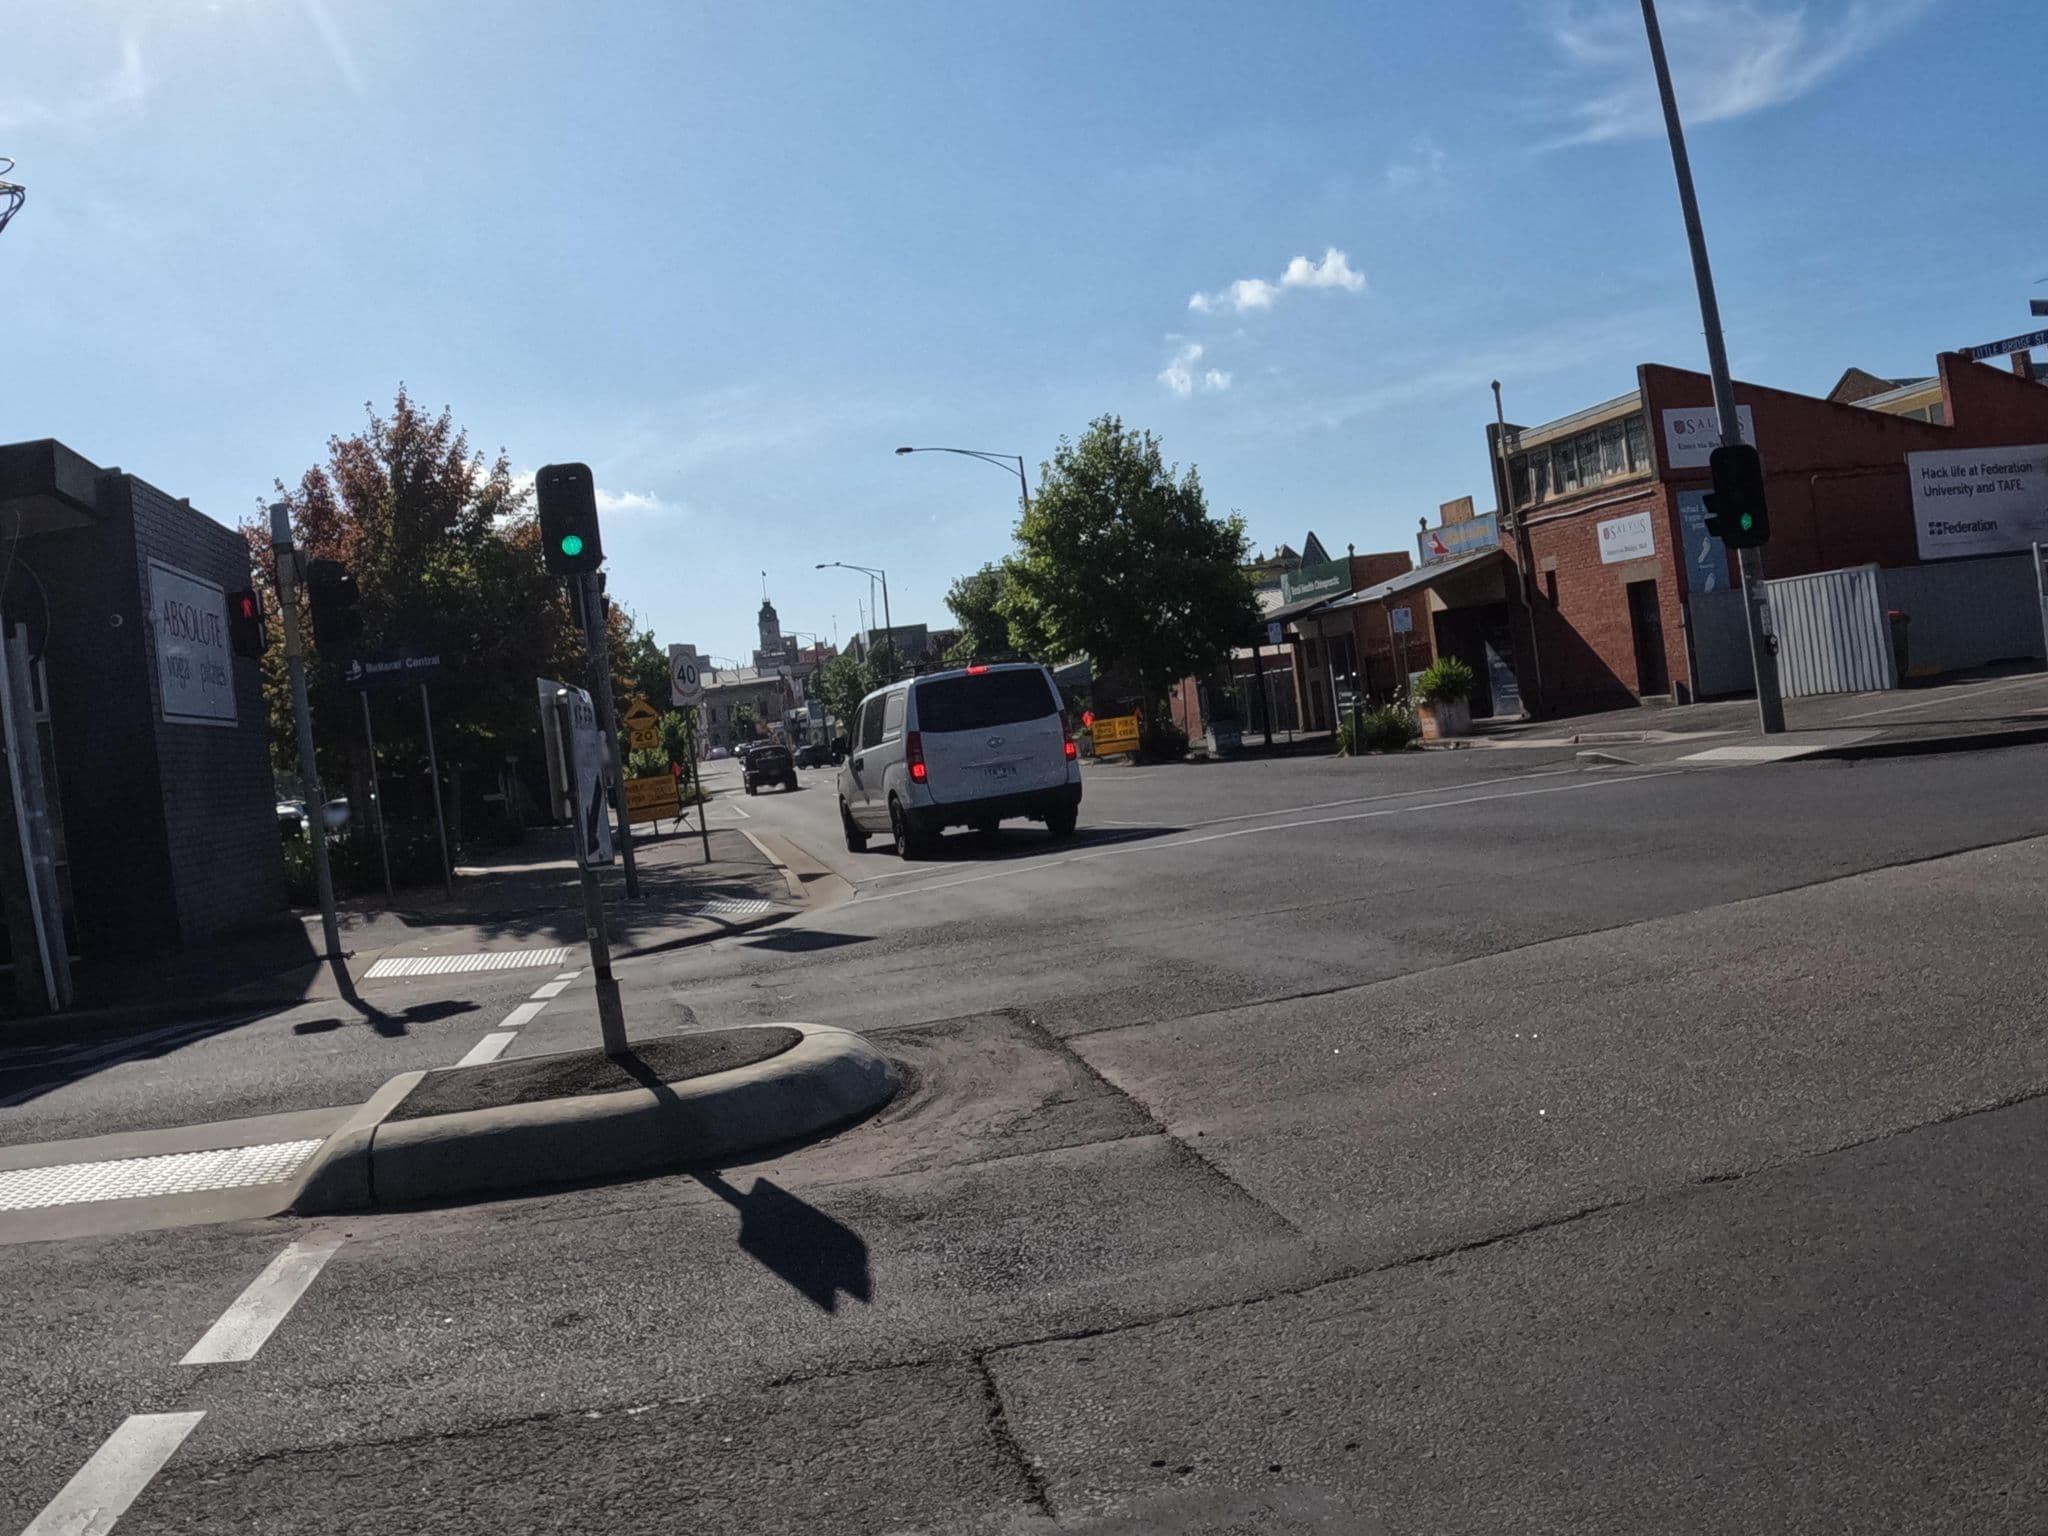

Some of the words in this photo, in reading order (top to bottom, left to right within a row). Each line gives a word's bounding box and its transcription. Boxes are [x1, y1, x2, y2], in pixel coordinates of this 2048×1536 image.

[1973, 344, 1998, 360] LITTLE
[2002, 336, 2031, 352] BRIDGE
[2035, 332, 2045, 345] ST
[1922, 466, 1948, 480] Hack
[1951, 465, 1964, 478] life
[1969, 464, 1978, 476] at
[1981, 462, 2033, 476] Federation
[1923, 484, 1975, 498] University
[1976, 482, 1996, 494] and
[1943, 520, 1998, 534] Federation
[163, 600, 222, 648] ABSOLUTE
[405, 655, 440, 668] Central
[677, 664, 695, 685] 40
[635, 731, 653, 742] 20
